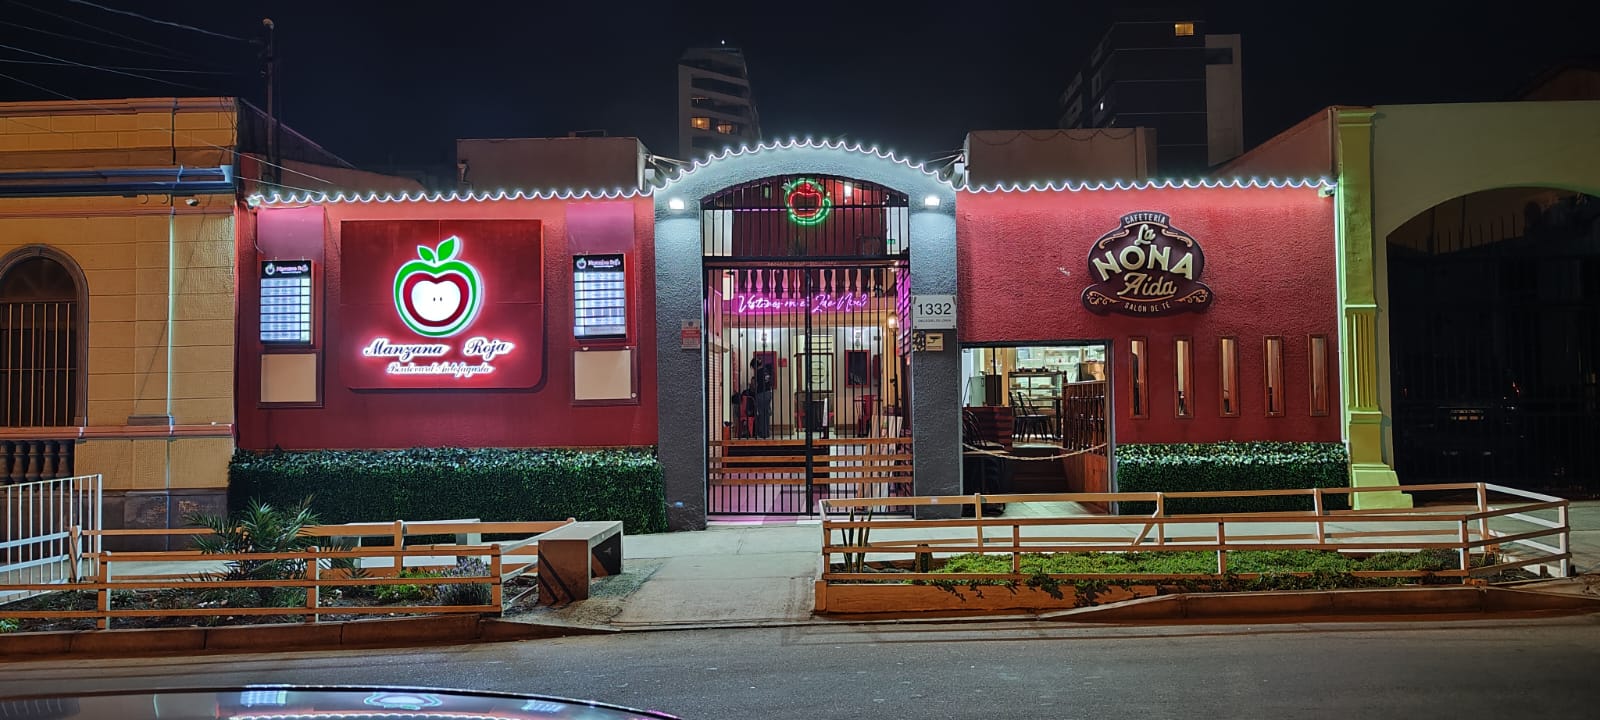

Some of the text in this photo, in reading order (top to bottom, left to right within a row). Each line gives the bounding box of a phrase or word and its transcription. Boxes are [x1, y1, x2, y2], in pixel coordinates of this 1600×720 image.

[1124, 213, 1166, 225] CAFETERÍA
[1134, 223, 1156, 246] La
[1092, 244, 1193, 281] NONA
[917, 302, 952, 316] 1332
[1150, 304, 1160, 312] DE
[364, 338, 508, 360] Manzana Roja
